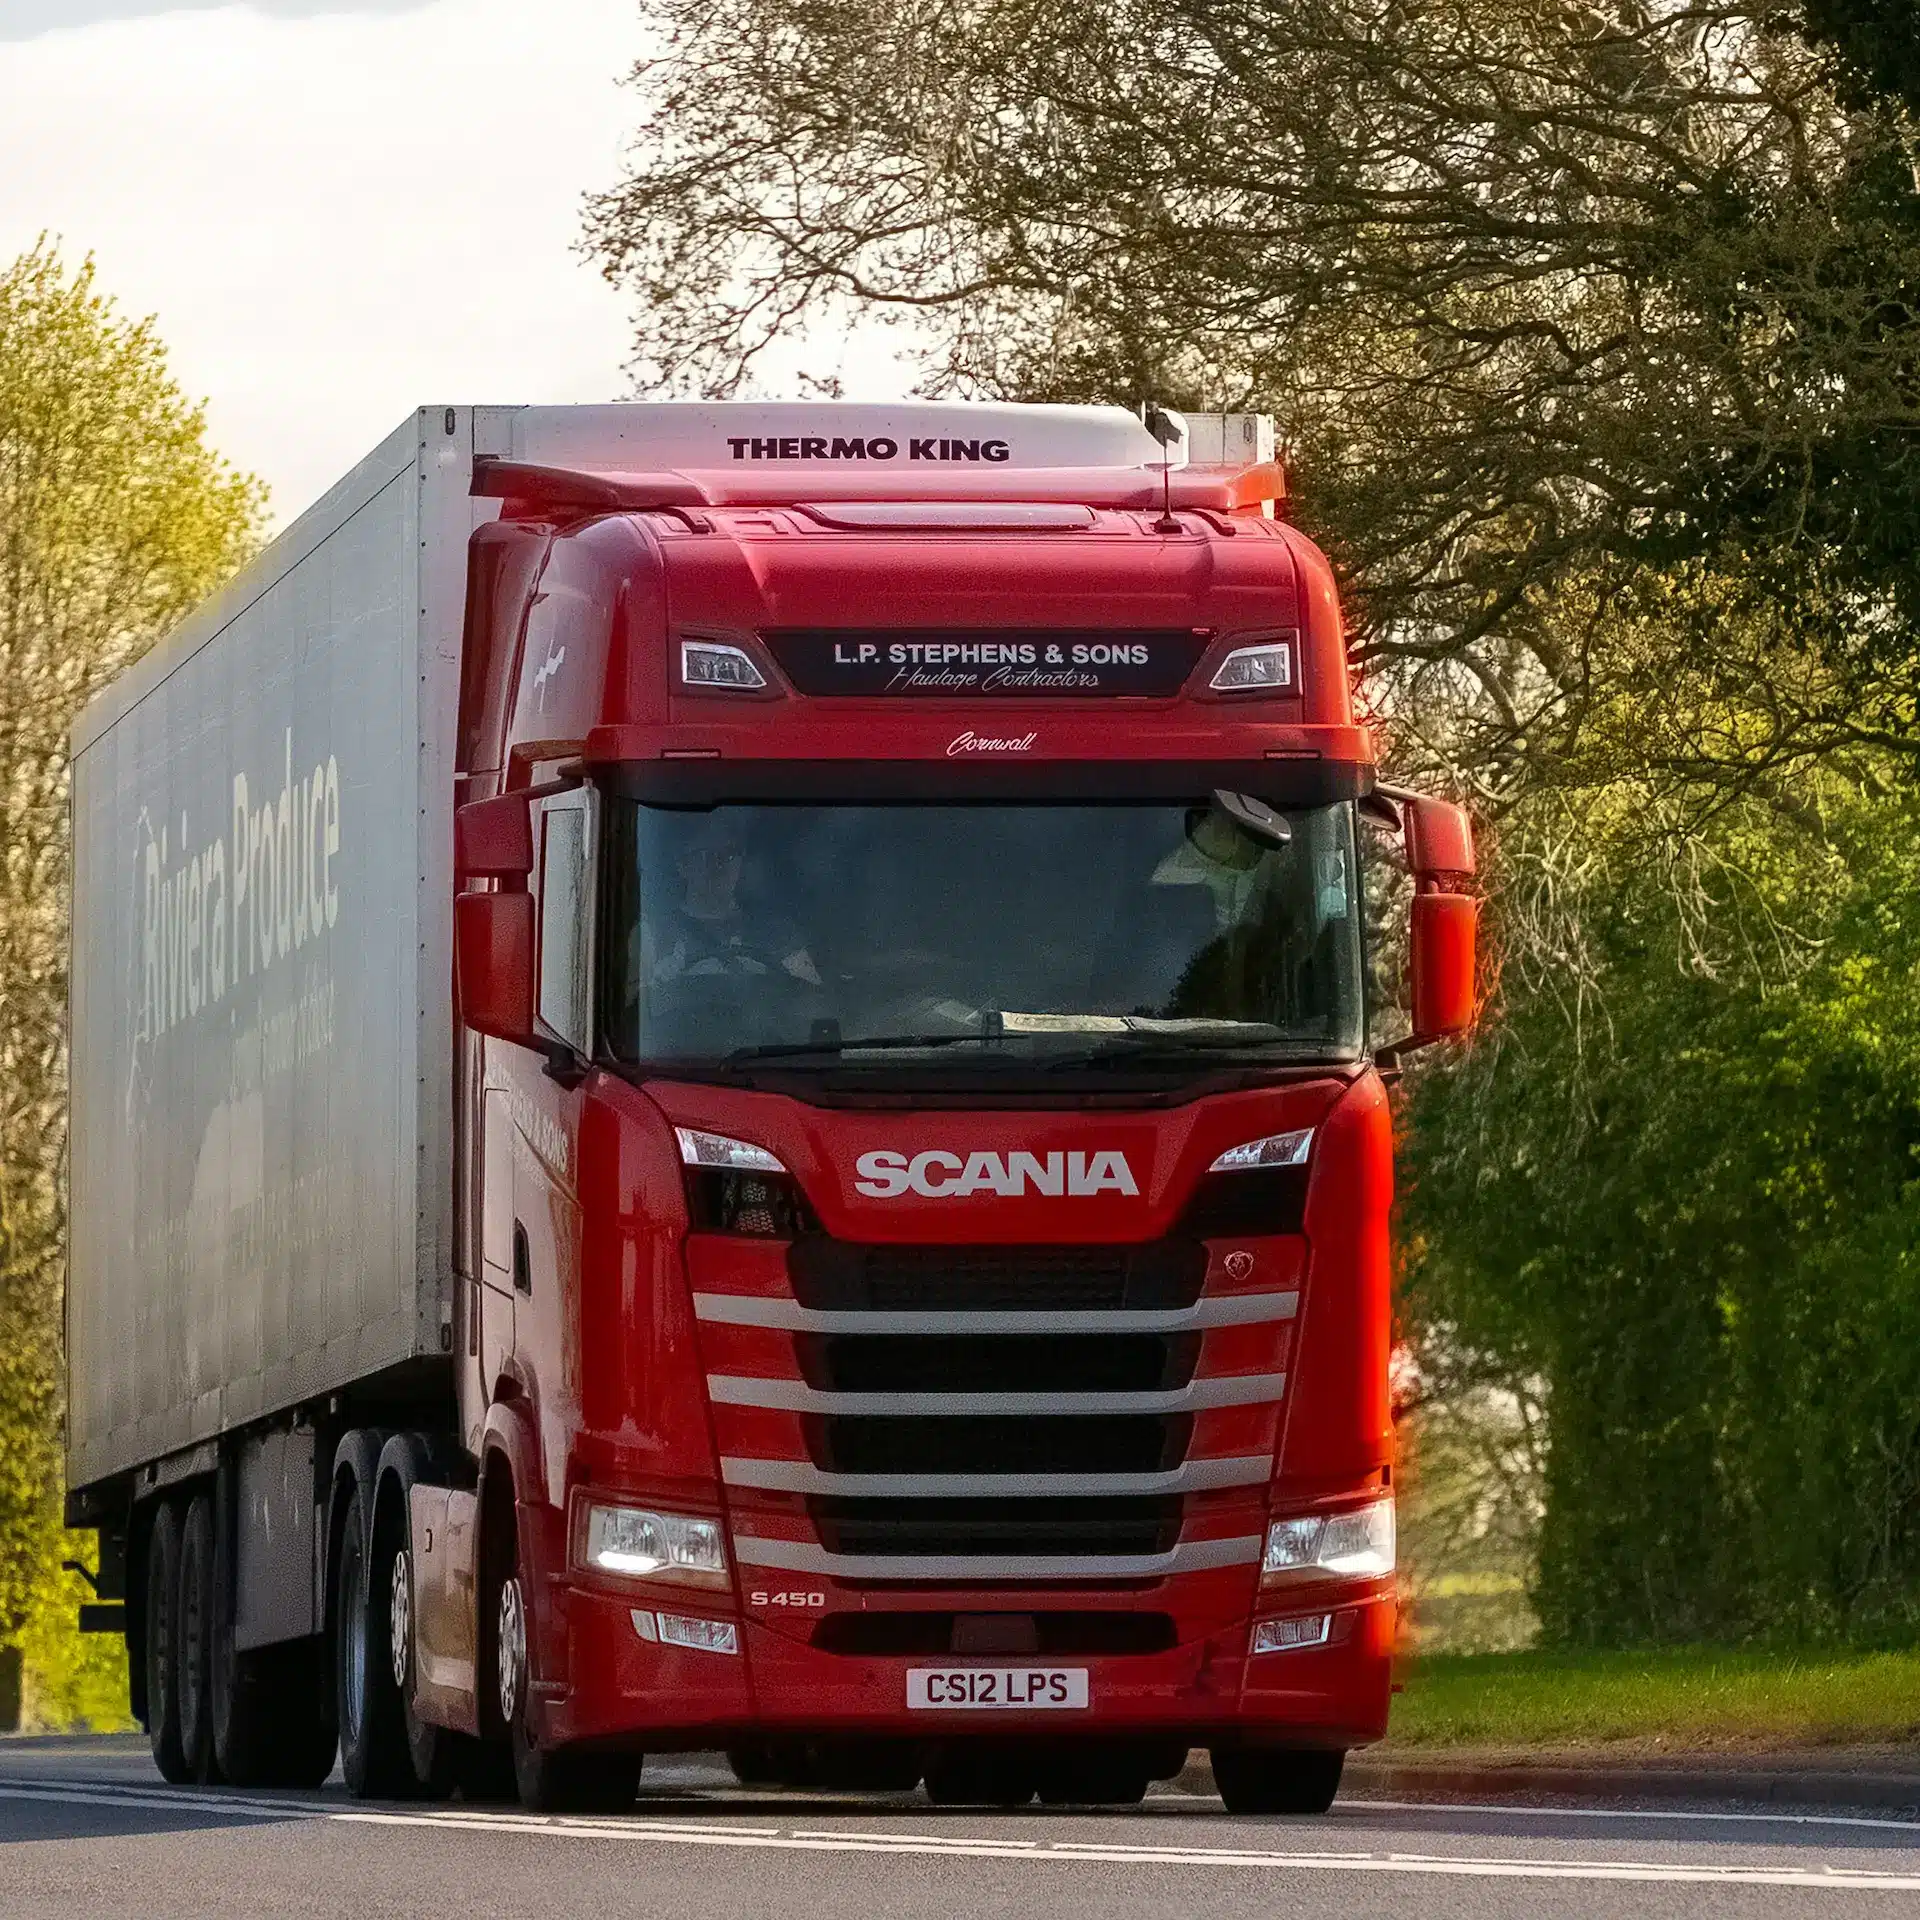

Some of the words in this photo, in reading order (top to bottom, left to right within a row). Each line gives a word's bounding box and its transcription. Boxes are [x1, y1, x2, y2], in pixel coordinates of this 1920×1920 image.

[727, 437, 898, 460] THERMO
[909, 438, 1010, 462] KING
[834, 643, 880, 664] L.P.
[888, 643, 1037, 664] STEPHENS
[1044, 643, 1064, 664] &
[1071, 644, 1149, 665] SONS
[884, 665, 977, 692] Haulage
[981, 665, 1100, 692] Contractors
[946, 731, 1038, 757] Cornwall
[144, 808, 226, 1041] Riviera
[232, 726, 340, 985] Produce
[854, 1149, 1141, 1198] SCANIA
[927, 1673, 997, 1703] CS12
[1006, 1673, 1068, 1703] LPS
